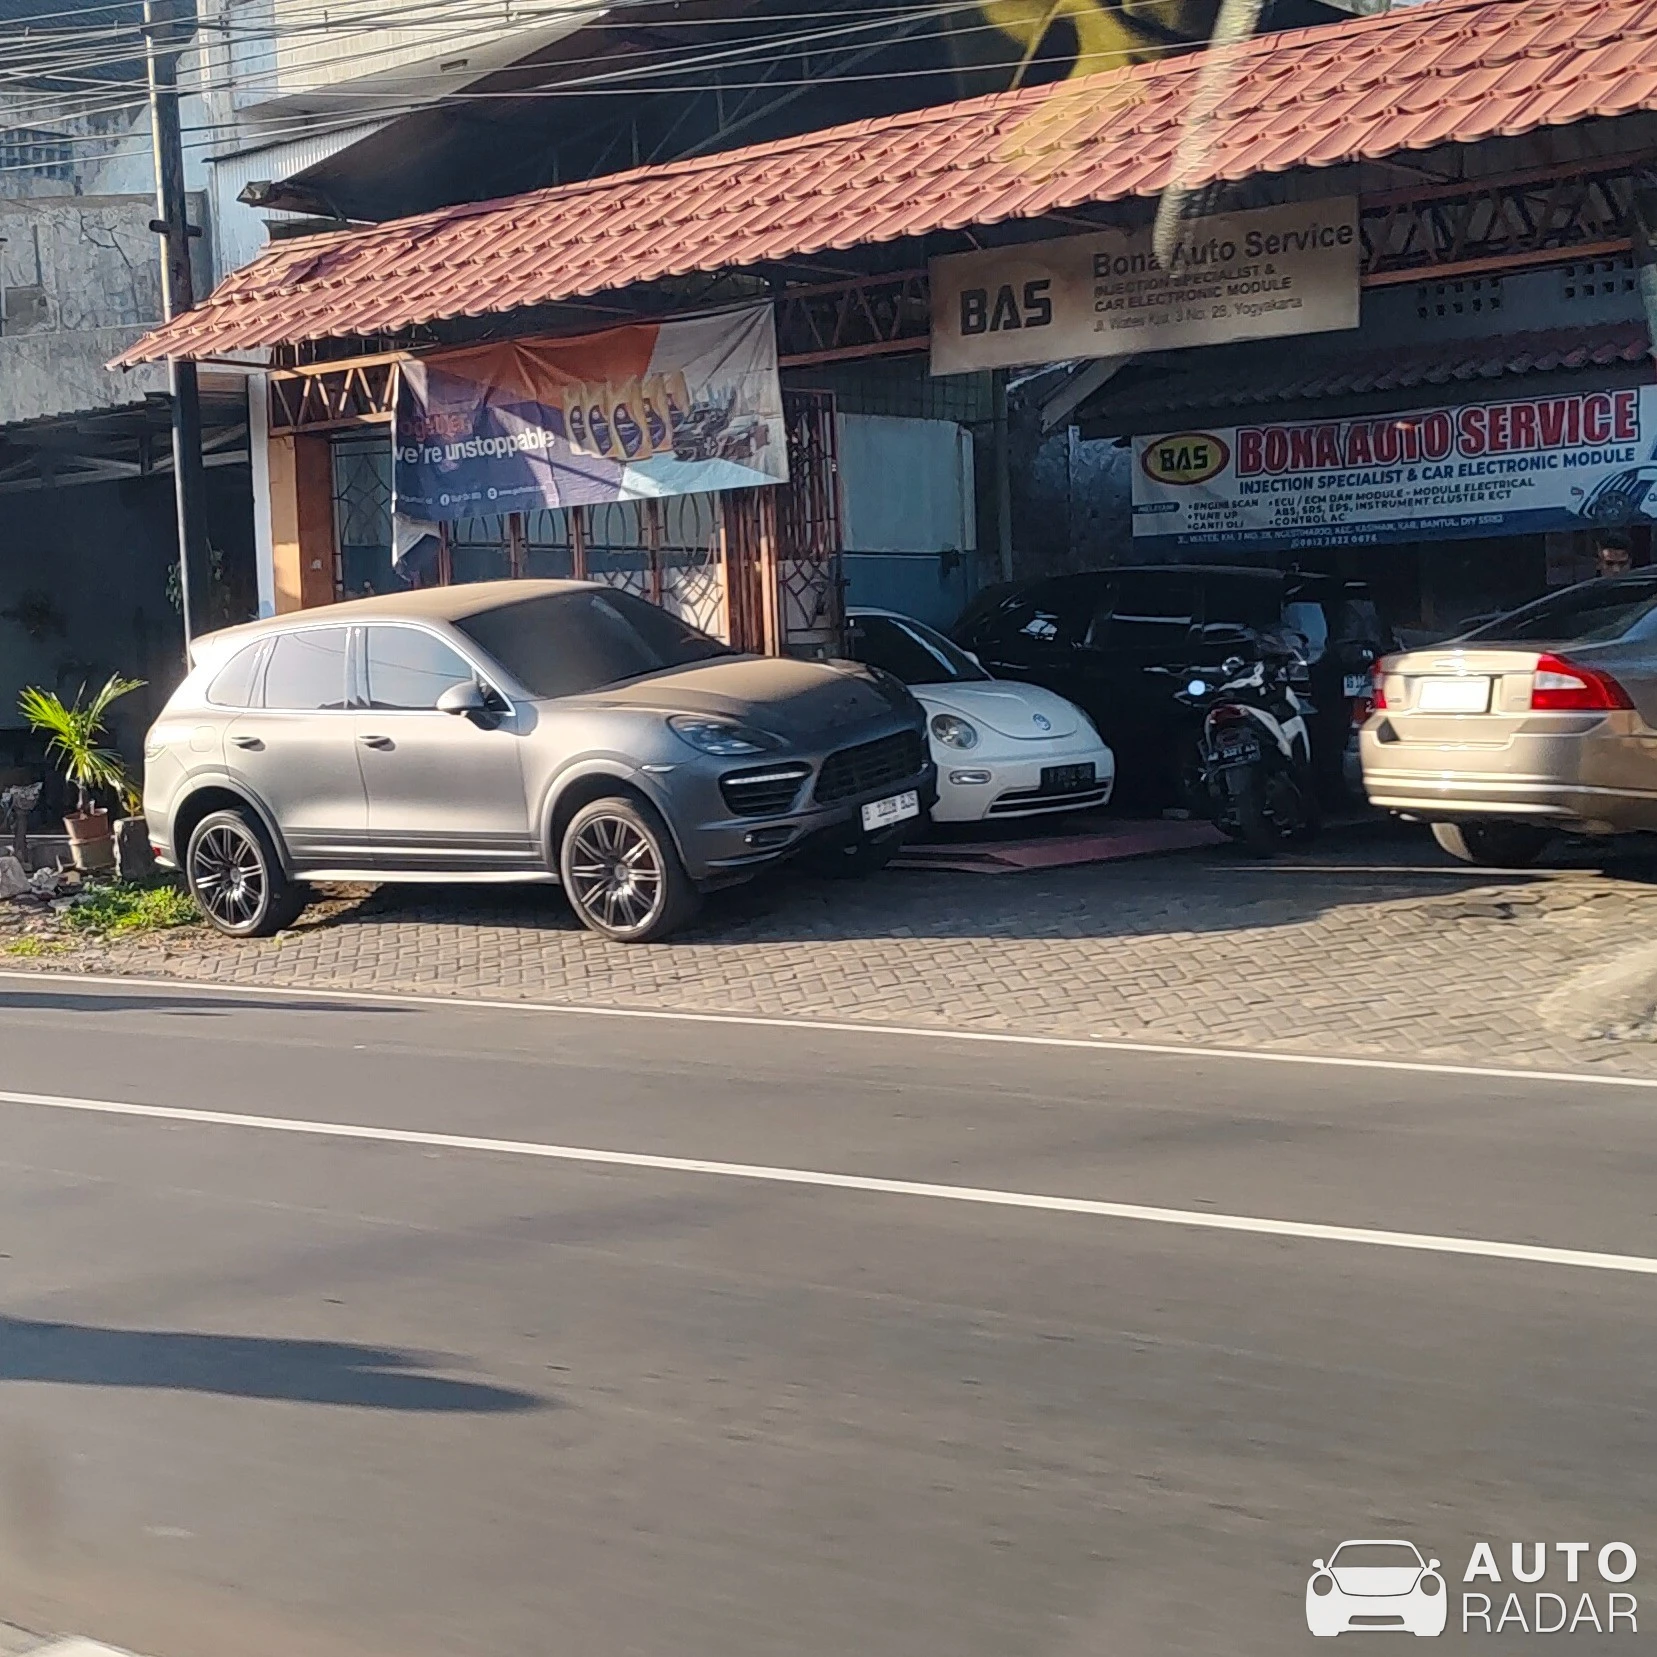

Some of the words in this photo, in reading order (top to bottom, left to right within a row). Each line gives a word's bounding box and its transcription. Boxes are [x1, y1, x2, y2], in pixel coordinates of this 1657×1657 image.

[1093, 252, 1163, 278] Bona
[1170, 239, 1236, 270] Auto
[1245, 223, 1354, 258] Service
[960, 279, 1053, 336] BAS
[1094, 299, 1124, 313] CAR
[1127, 286, 1223, 309] ELECTRONIC
[1227, 276, 1293, 297] MODULE
[446, 426, 555, 460] unstoppable
[1236, 427, 1345, 477] BONA
[1344, 411, 1454, 467] AUTO
[1458, 388, 1640, 457] SERVICE
[1160, 445, 1208, 471] BAS
[1239, 476, 1313, 495] INJECTION
[1317, 469, 1403, 488] SPECIALIST
[1407, 468, 1418, 482] &
[1422, 465, 1454, 481] CAR
[1458, 451, 1558, 478] ELECTRONIC
[1563, 446, 1636, 468] MODULE
[1274, 497, 1294, 507] ECU
[1305, 495, 1326, 505] ECM
[1356, 488, 1403, 500] MODULE
[1413, 484, 1461, 496] MODULE
[1464, 477, 1535, 492] ELECTRICAL
[1356, 497, 1428, 510] INSTRUMENT
[1433, 491, 1485, 505] CLUSTER
[1489, 489, 1511, 501] ECT
[1274, 515, 1326, 526] CONTROL
[1330, 513, 1345, 522] AC
